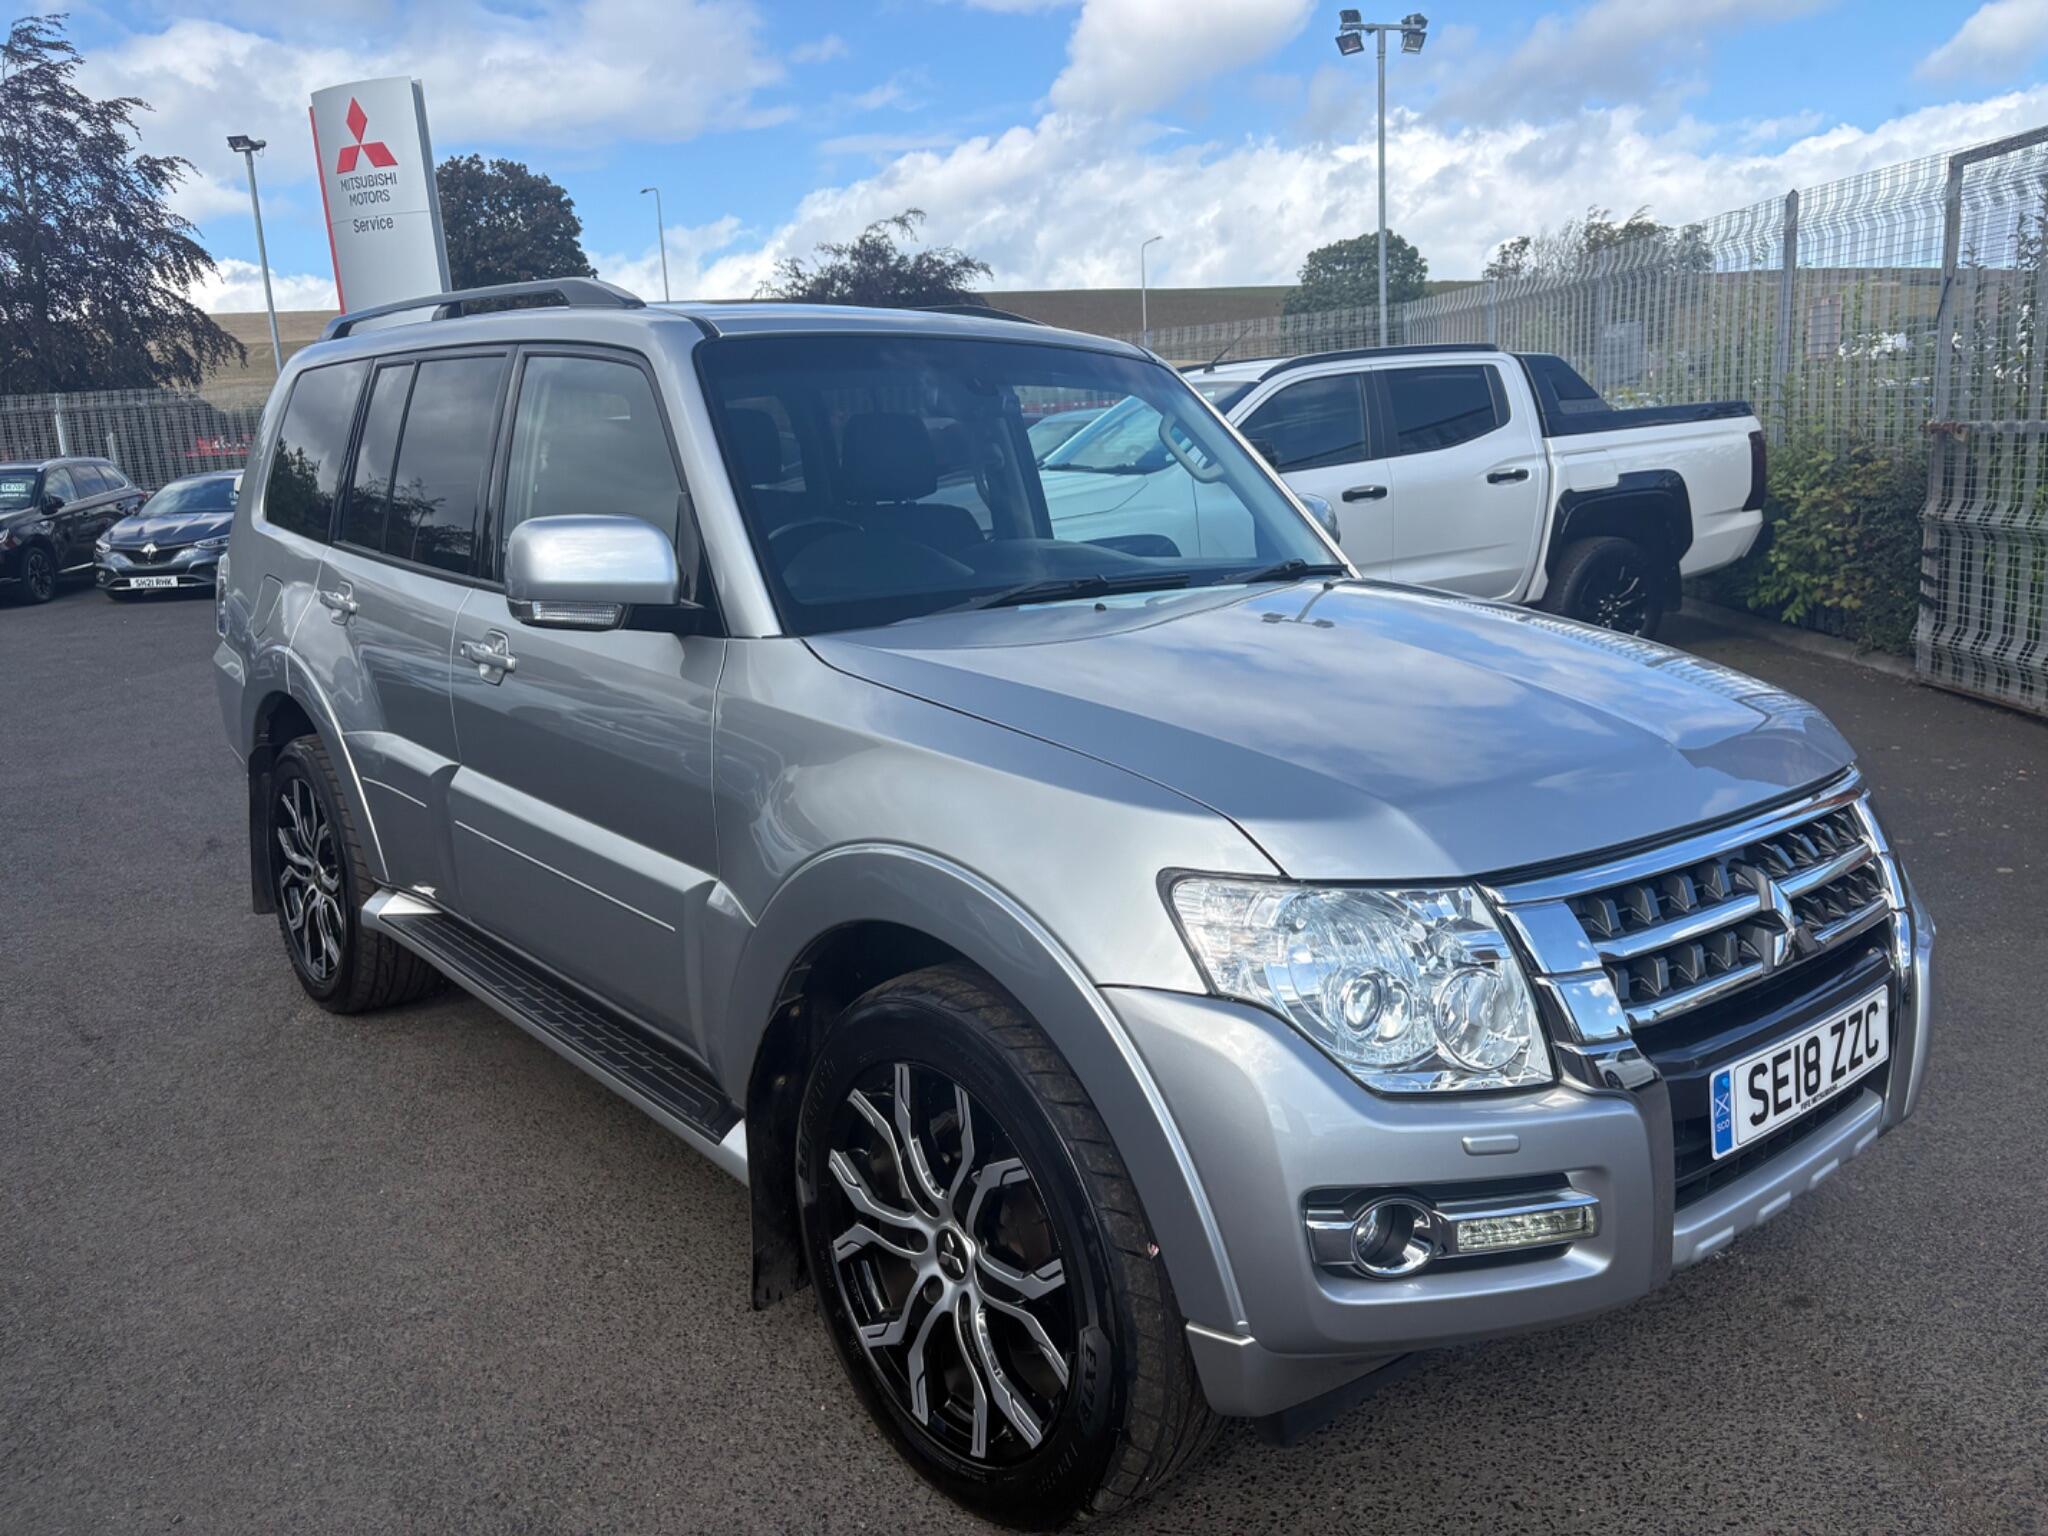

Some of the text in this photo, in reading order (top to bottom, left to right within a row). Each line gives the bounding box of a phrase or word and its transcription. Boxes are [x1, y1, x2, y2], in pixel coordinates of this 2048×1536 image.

[340, 172, 398, 192] MITSUBISHI
[349, 189, 391, 206] MOTORS
[353, 216, 394, 233] Service
[1748, 1001, 1879, 1127] SE18 ZZC
